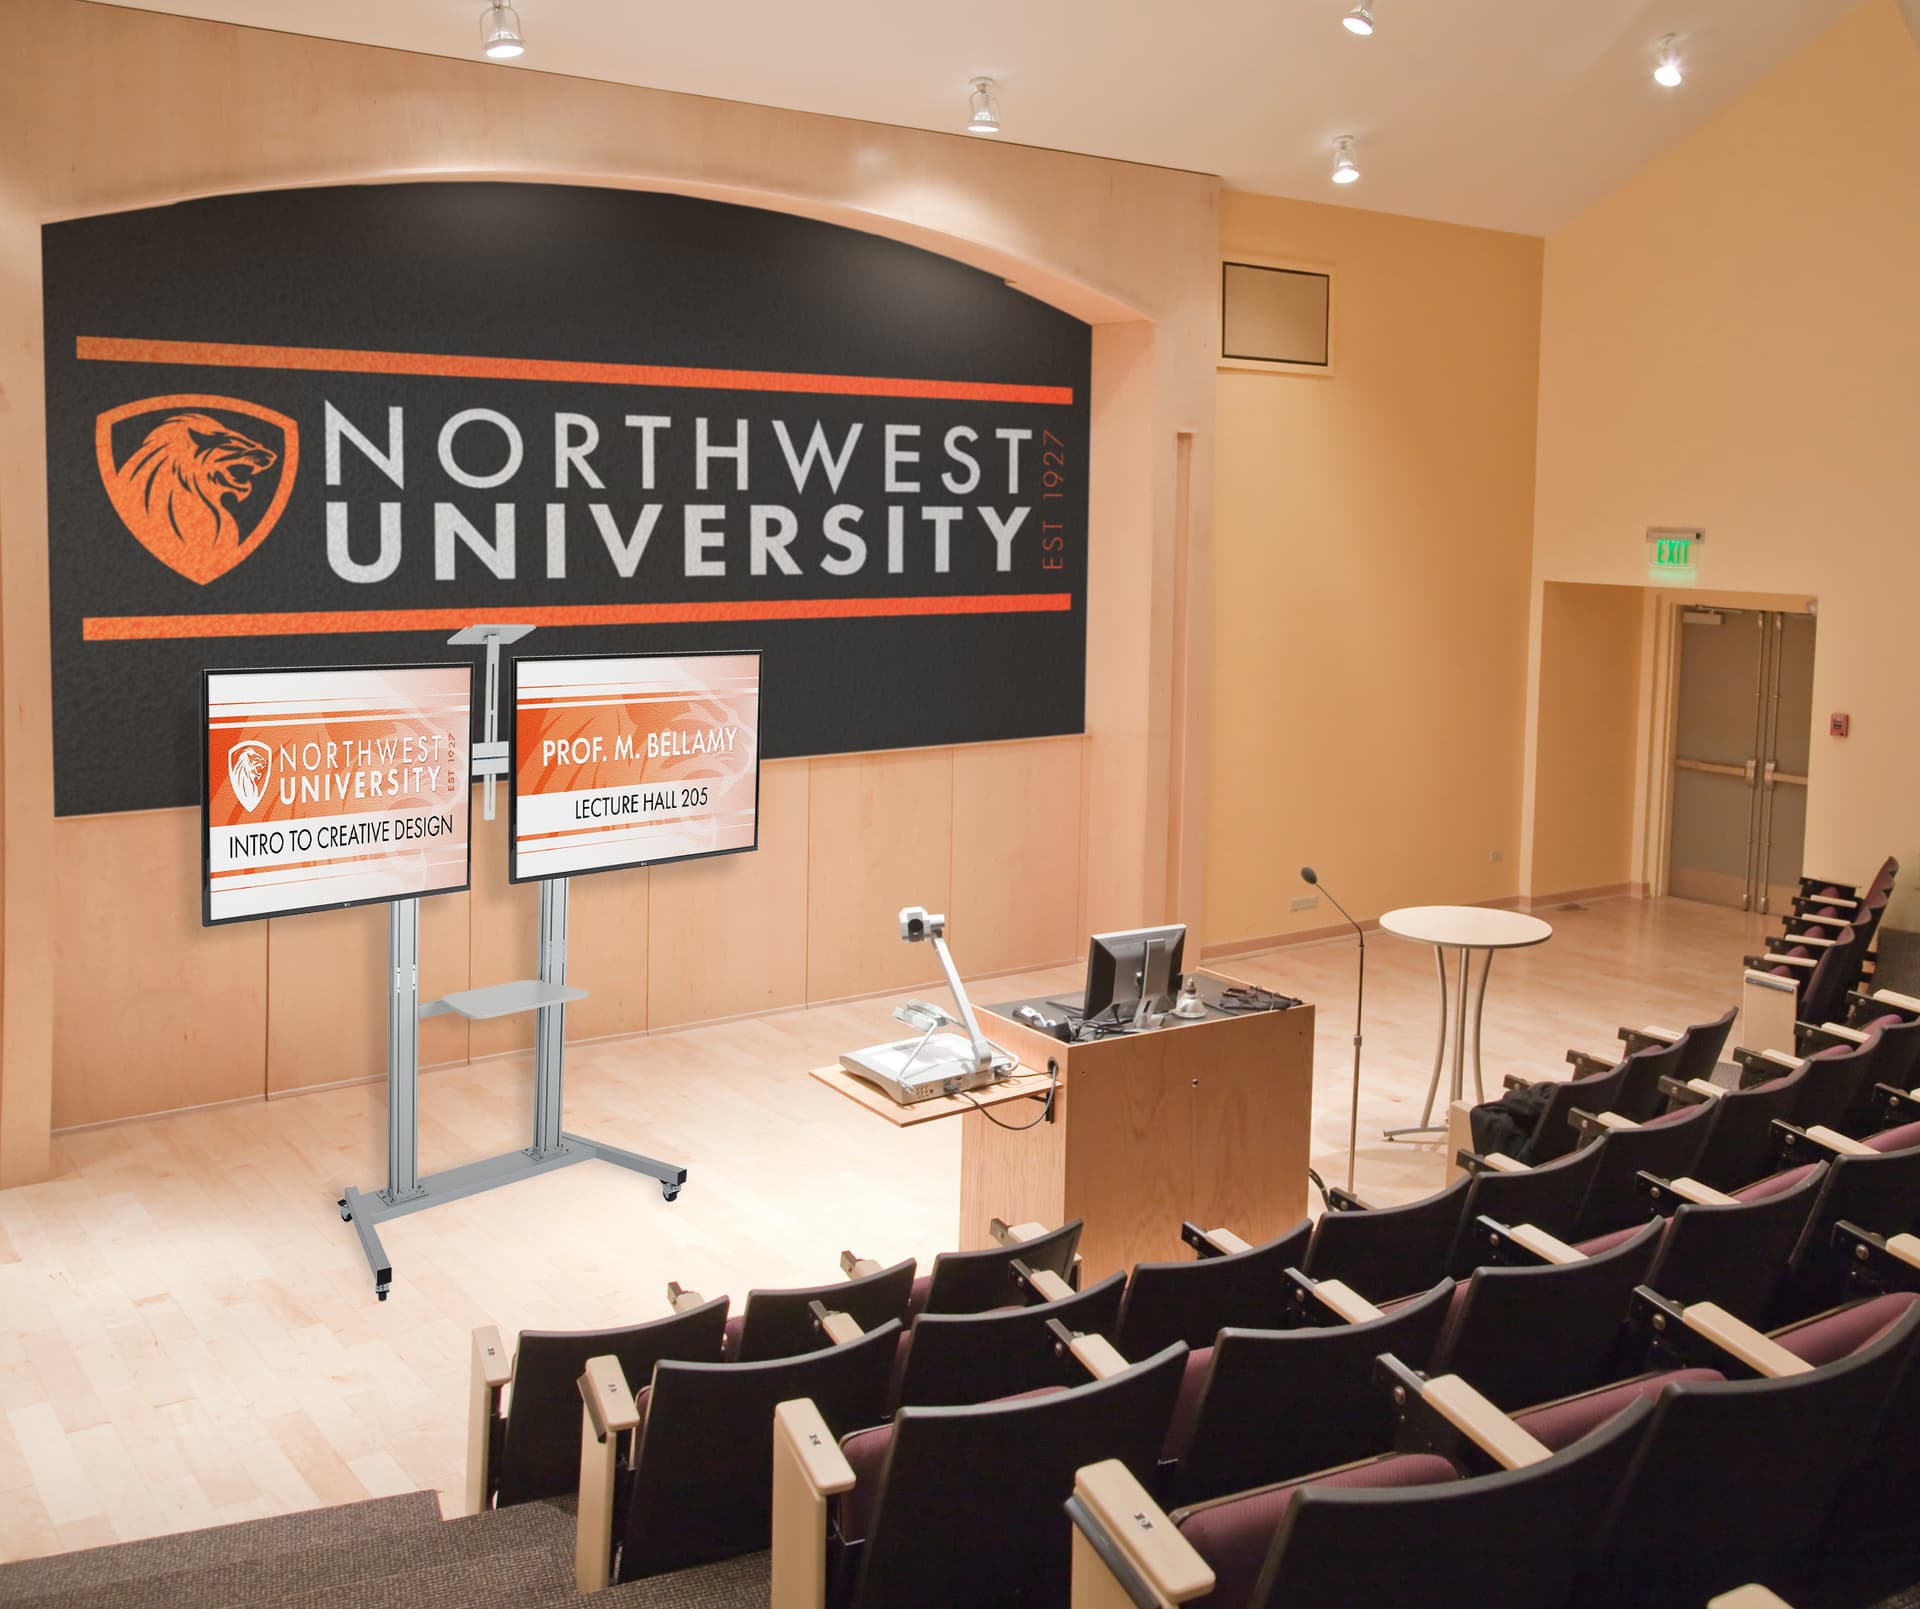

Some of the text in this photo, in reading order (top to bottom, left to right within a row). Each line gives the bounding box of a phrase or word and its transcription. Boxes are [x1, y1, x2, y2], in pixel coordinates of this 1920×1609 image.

[324, 399, 1033, 496] NORTHWEST
[1042, 429, 1065, 571] EST 1927
[325, 501, 1031, 584] UNIVERSITY
[1657, 539, 1690, 565] EXIT
[279, 735, 442, 773] NORTHWEST
[447, 732, 457, 792] EST 1927
[543, 727, 738, 767] PROF. M. BELLAMY
[279, 765, 442, 805] UNIVERSITY
[575, 787, 708, 819] LECTURE HALL 205
[229, 814, 453, 859] INTRO TO CREATIVE DESIGN
